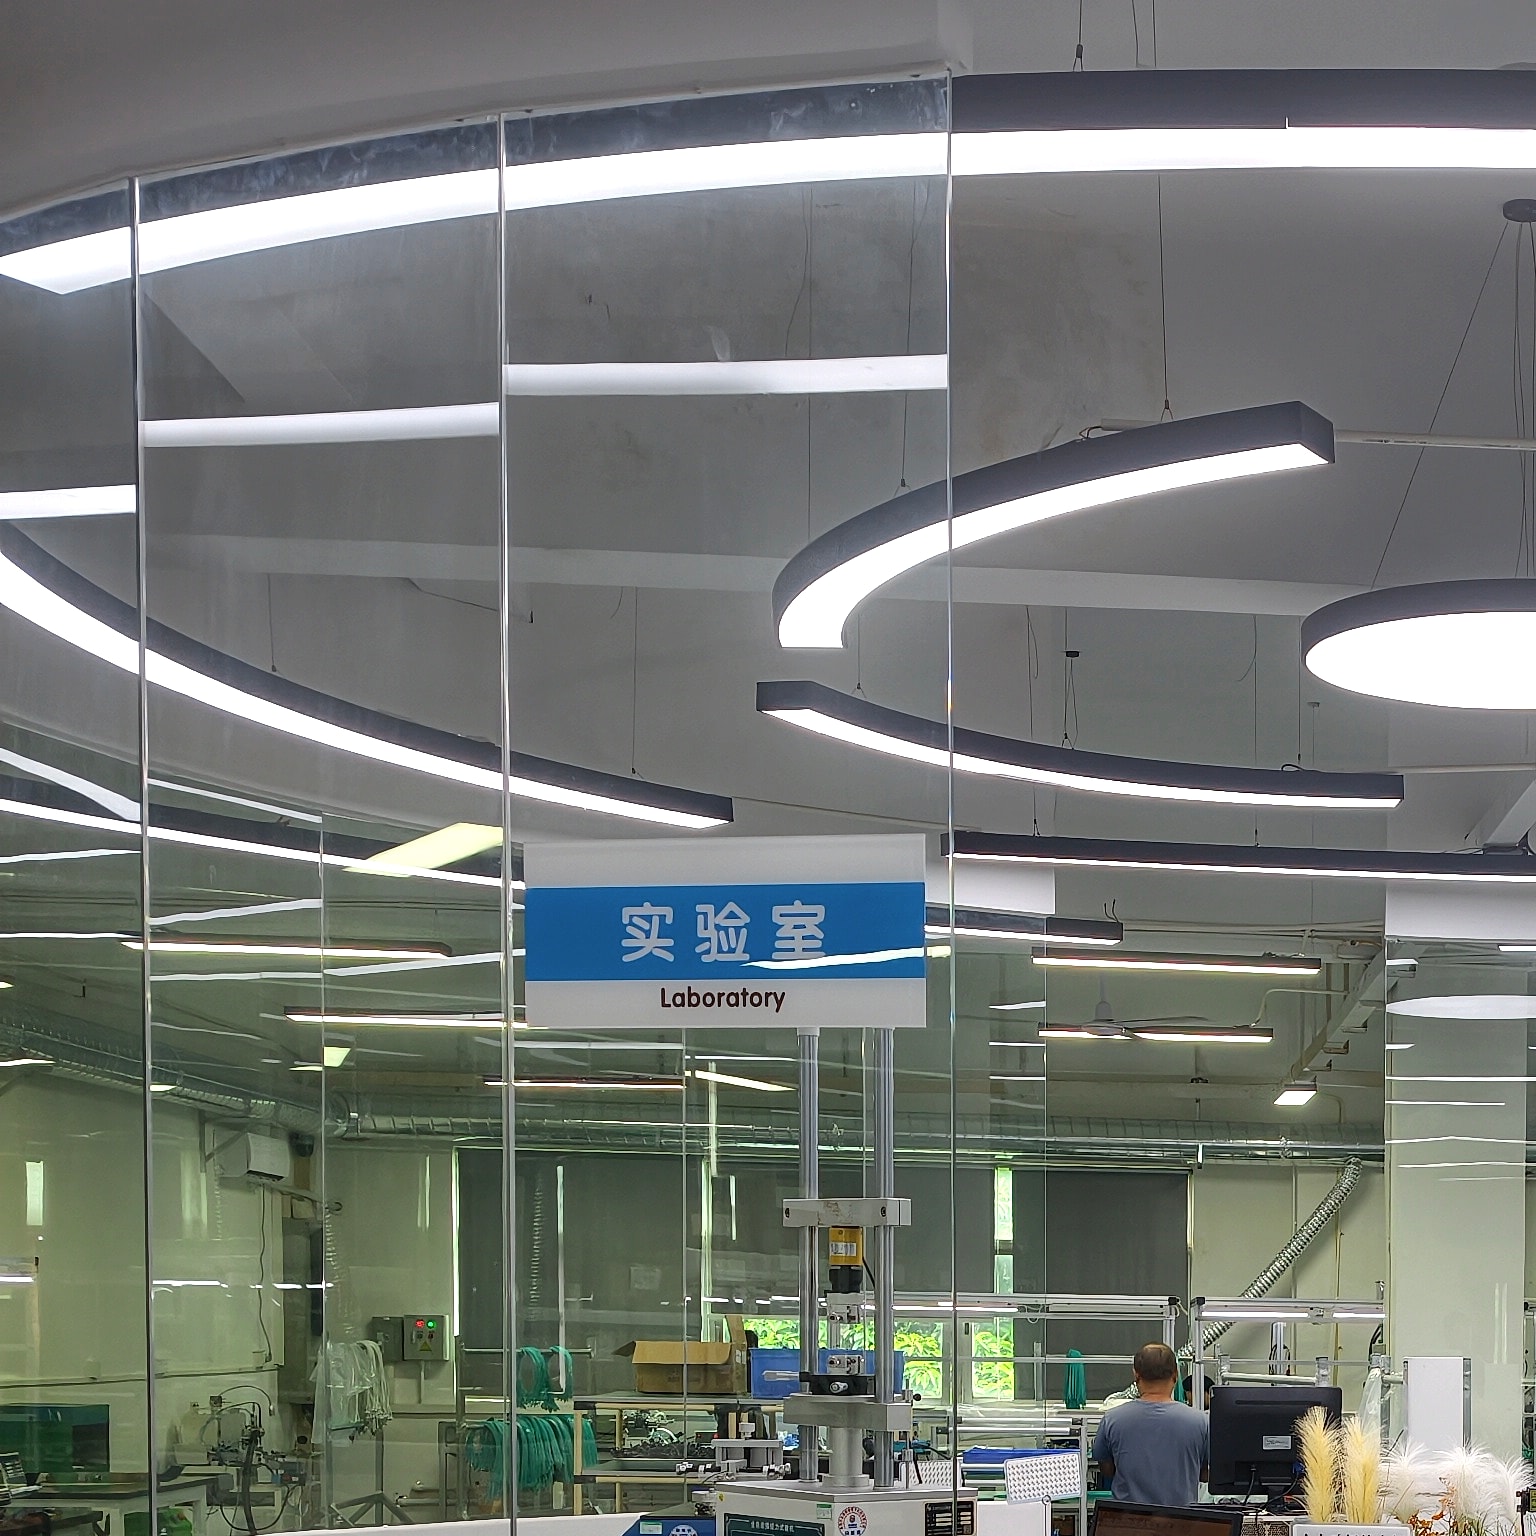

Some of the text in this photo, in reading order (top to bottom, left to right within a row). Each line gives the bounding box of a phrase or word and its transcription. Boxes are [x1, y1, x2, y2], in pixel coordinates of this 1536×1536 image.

[621, 900, 826, 963] 实验室
[660, 986, 786, 1013] Laboratory
